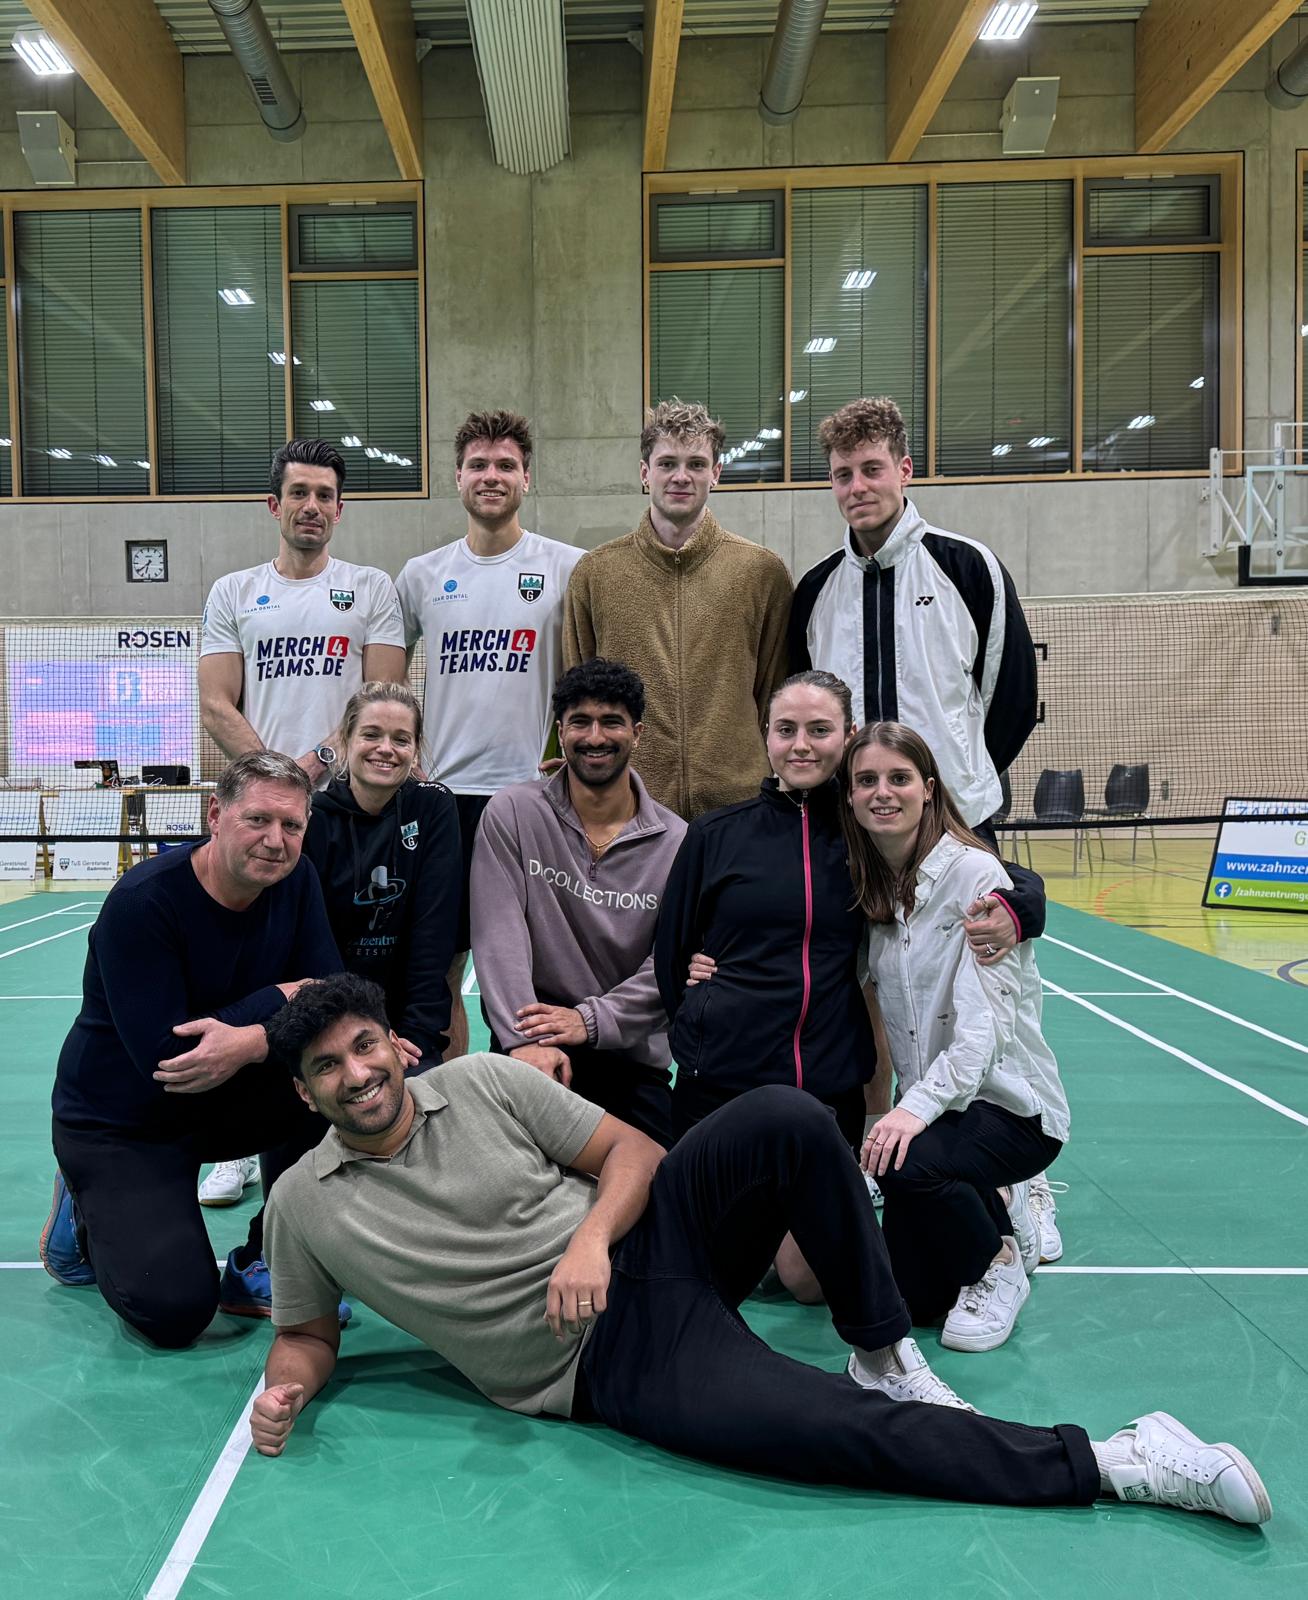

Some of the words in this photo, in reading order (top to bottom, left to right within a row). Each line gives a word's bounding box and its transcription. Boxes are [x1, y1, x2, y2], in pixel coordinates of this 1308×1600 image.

[527, 591, 534, 600] G
[338, 602, 346, 611] G
[118, 631, 191, 649] ROSEN
[257, 658, 345, 682] TEAMS.DE
[440, 652, 531, 675] TEAMS.DE
[166, 824, 195, 832] ROSEN
